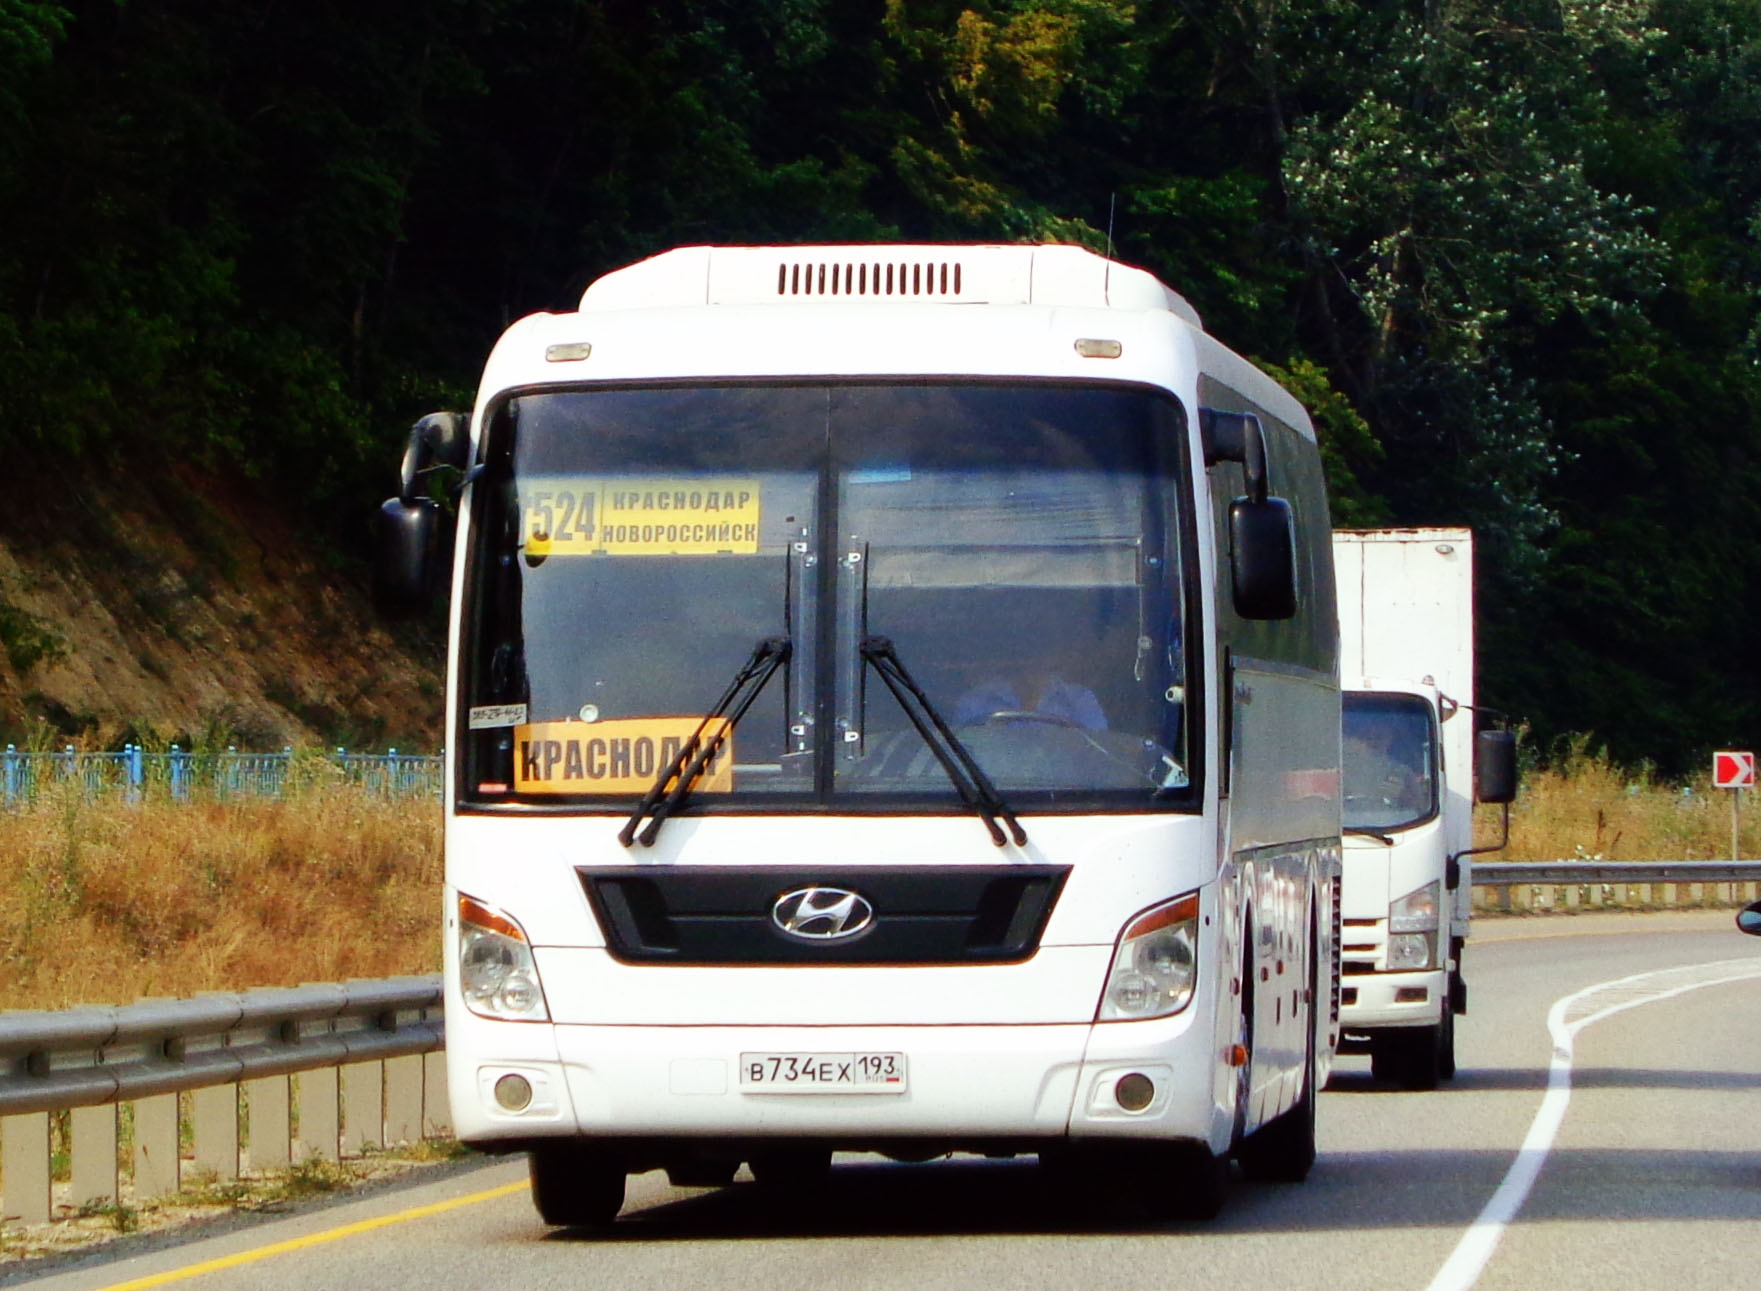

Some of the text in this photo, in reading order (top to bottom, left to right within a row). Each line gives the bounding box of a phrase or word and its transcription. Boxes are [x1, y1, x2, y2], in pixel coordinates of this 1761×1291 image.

[613, 491, 750, 512] КРАСНОДАР
[602, 521, 756, 543] НОВОРОССИЙСК
[858, 1055, 896, 1075] 193
